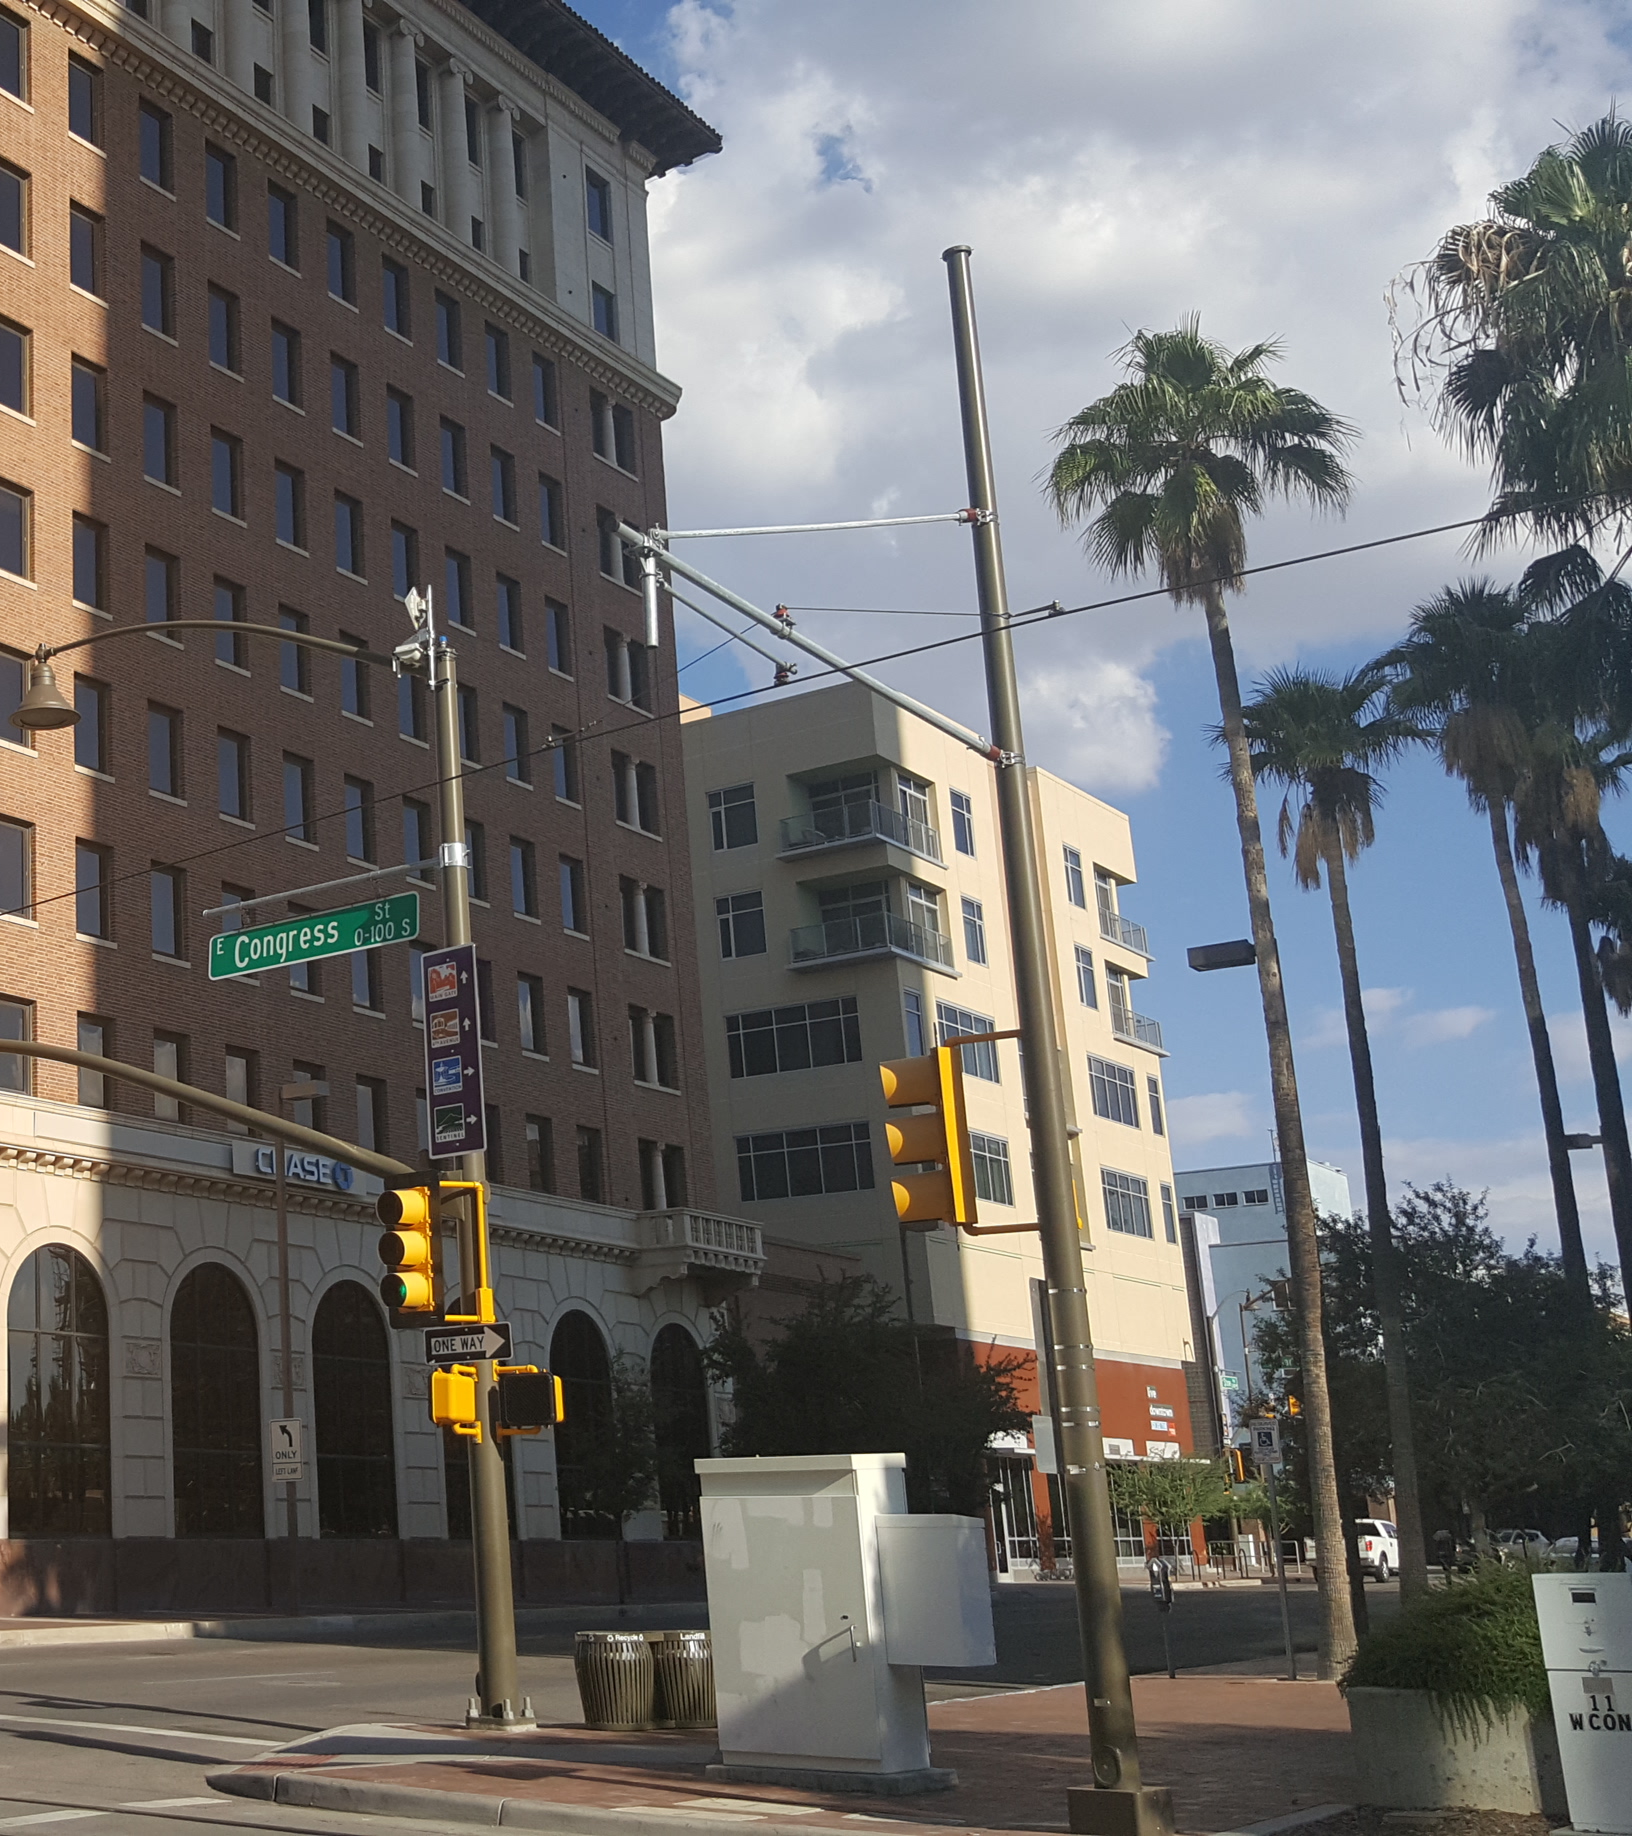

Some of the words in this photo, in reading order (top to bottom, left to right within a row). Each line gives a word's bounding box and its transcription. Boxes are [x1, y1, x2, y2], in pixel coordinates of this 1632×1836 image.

[216, 938, 225, 955] E
[234, 921, 339, 968] Congress
[375, 901, 390, 920] St
[354, 922, 395, 946] 0-100
[401, 919, 410, 936] S
[436, 1132, 464, 1141] SENTINEL
[433, 1338, 457, 1353] ONE
[460, 1336, 484, 1351] WAY
[275, 1450, 297, 1460] ONLY
[275, 1467, 286, 1475] LEFT
[615, 1634, 638, 1642] Recycle
[680, 1632, 706, 1640] Landfill
[1589, 1694, 1615, 1712] 11
